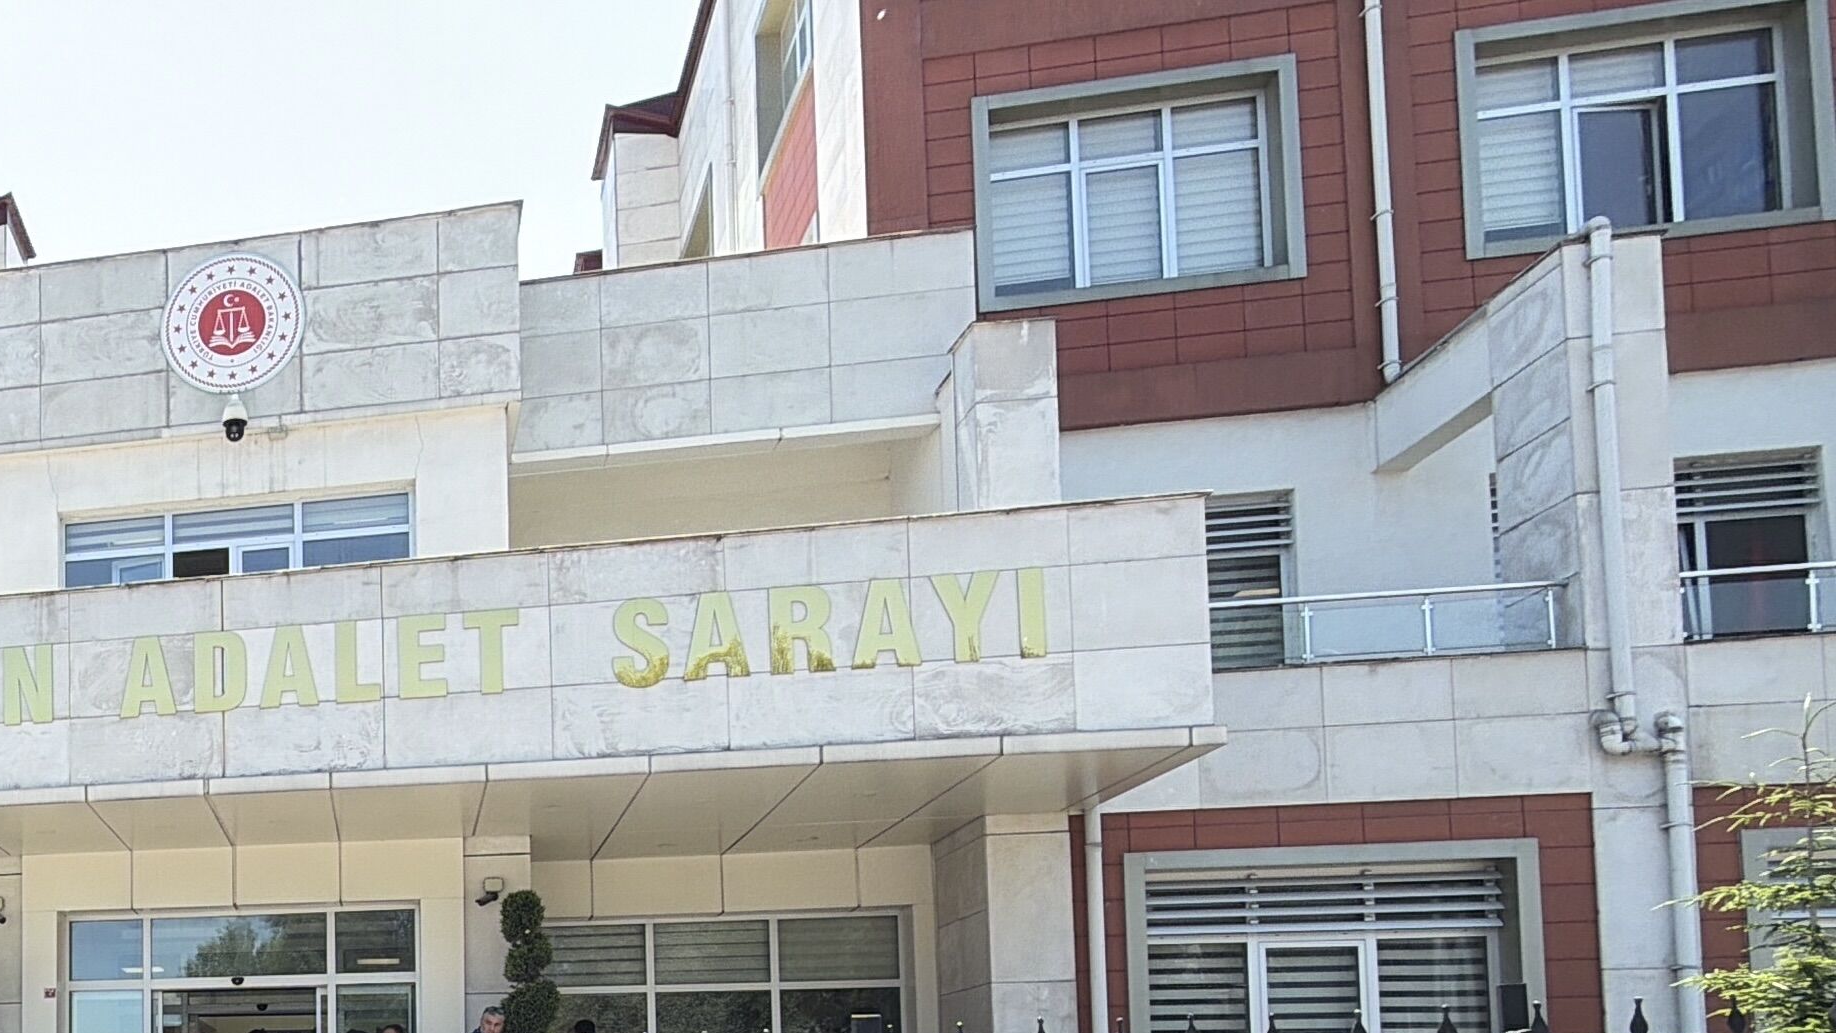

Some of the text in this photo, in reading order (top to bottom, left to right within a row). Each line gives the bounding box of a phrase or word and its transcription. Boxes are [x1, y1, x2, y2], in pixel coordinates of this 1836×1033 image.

[239, 282, 270, 302] ADALET
[119, 608, 520, 719] ADALET
[611, 566, 1048, 689] SARAYI
